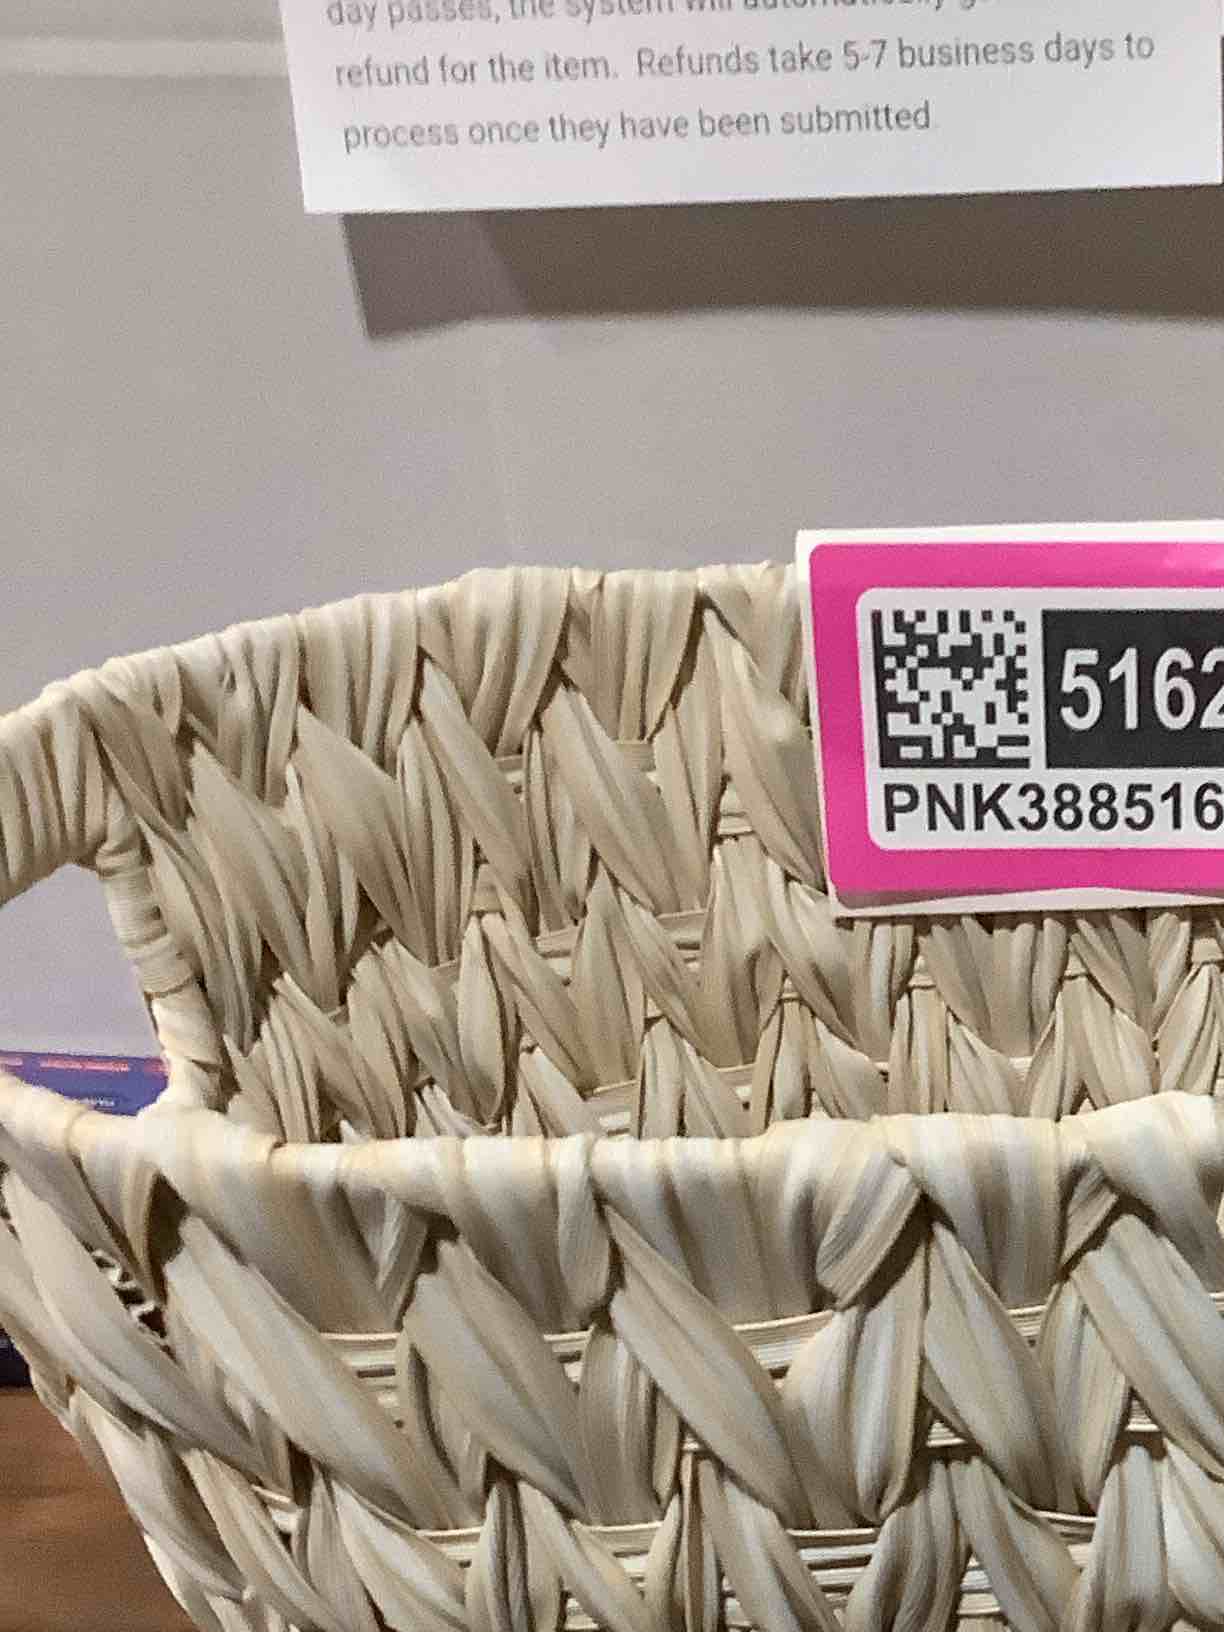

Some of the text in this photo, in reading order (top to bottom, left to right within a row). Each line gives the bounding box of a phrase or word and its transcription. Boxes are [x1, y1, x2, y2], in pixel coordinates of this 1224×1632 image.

[326, 0, 377, 31] day
[337, 32, 1155, 87] refund for the item. Refunds take 5-7 business days to
[344, 122, 459, 154] process
[468, 120, 540, 146] once
[548, 113, 609, 149] they
[620, 110, 689, 139] have
[698, 106, 770, 138] been
